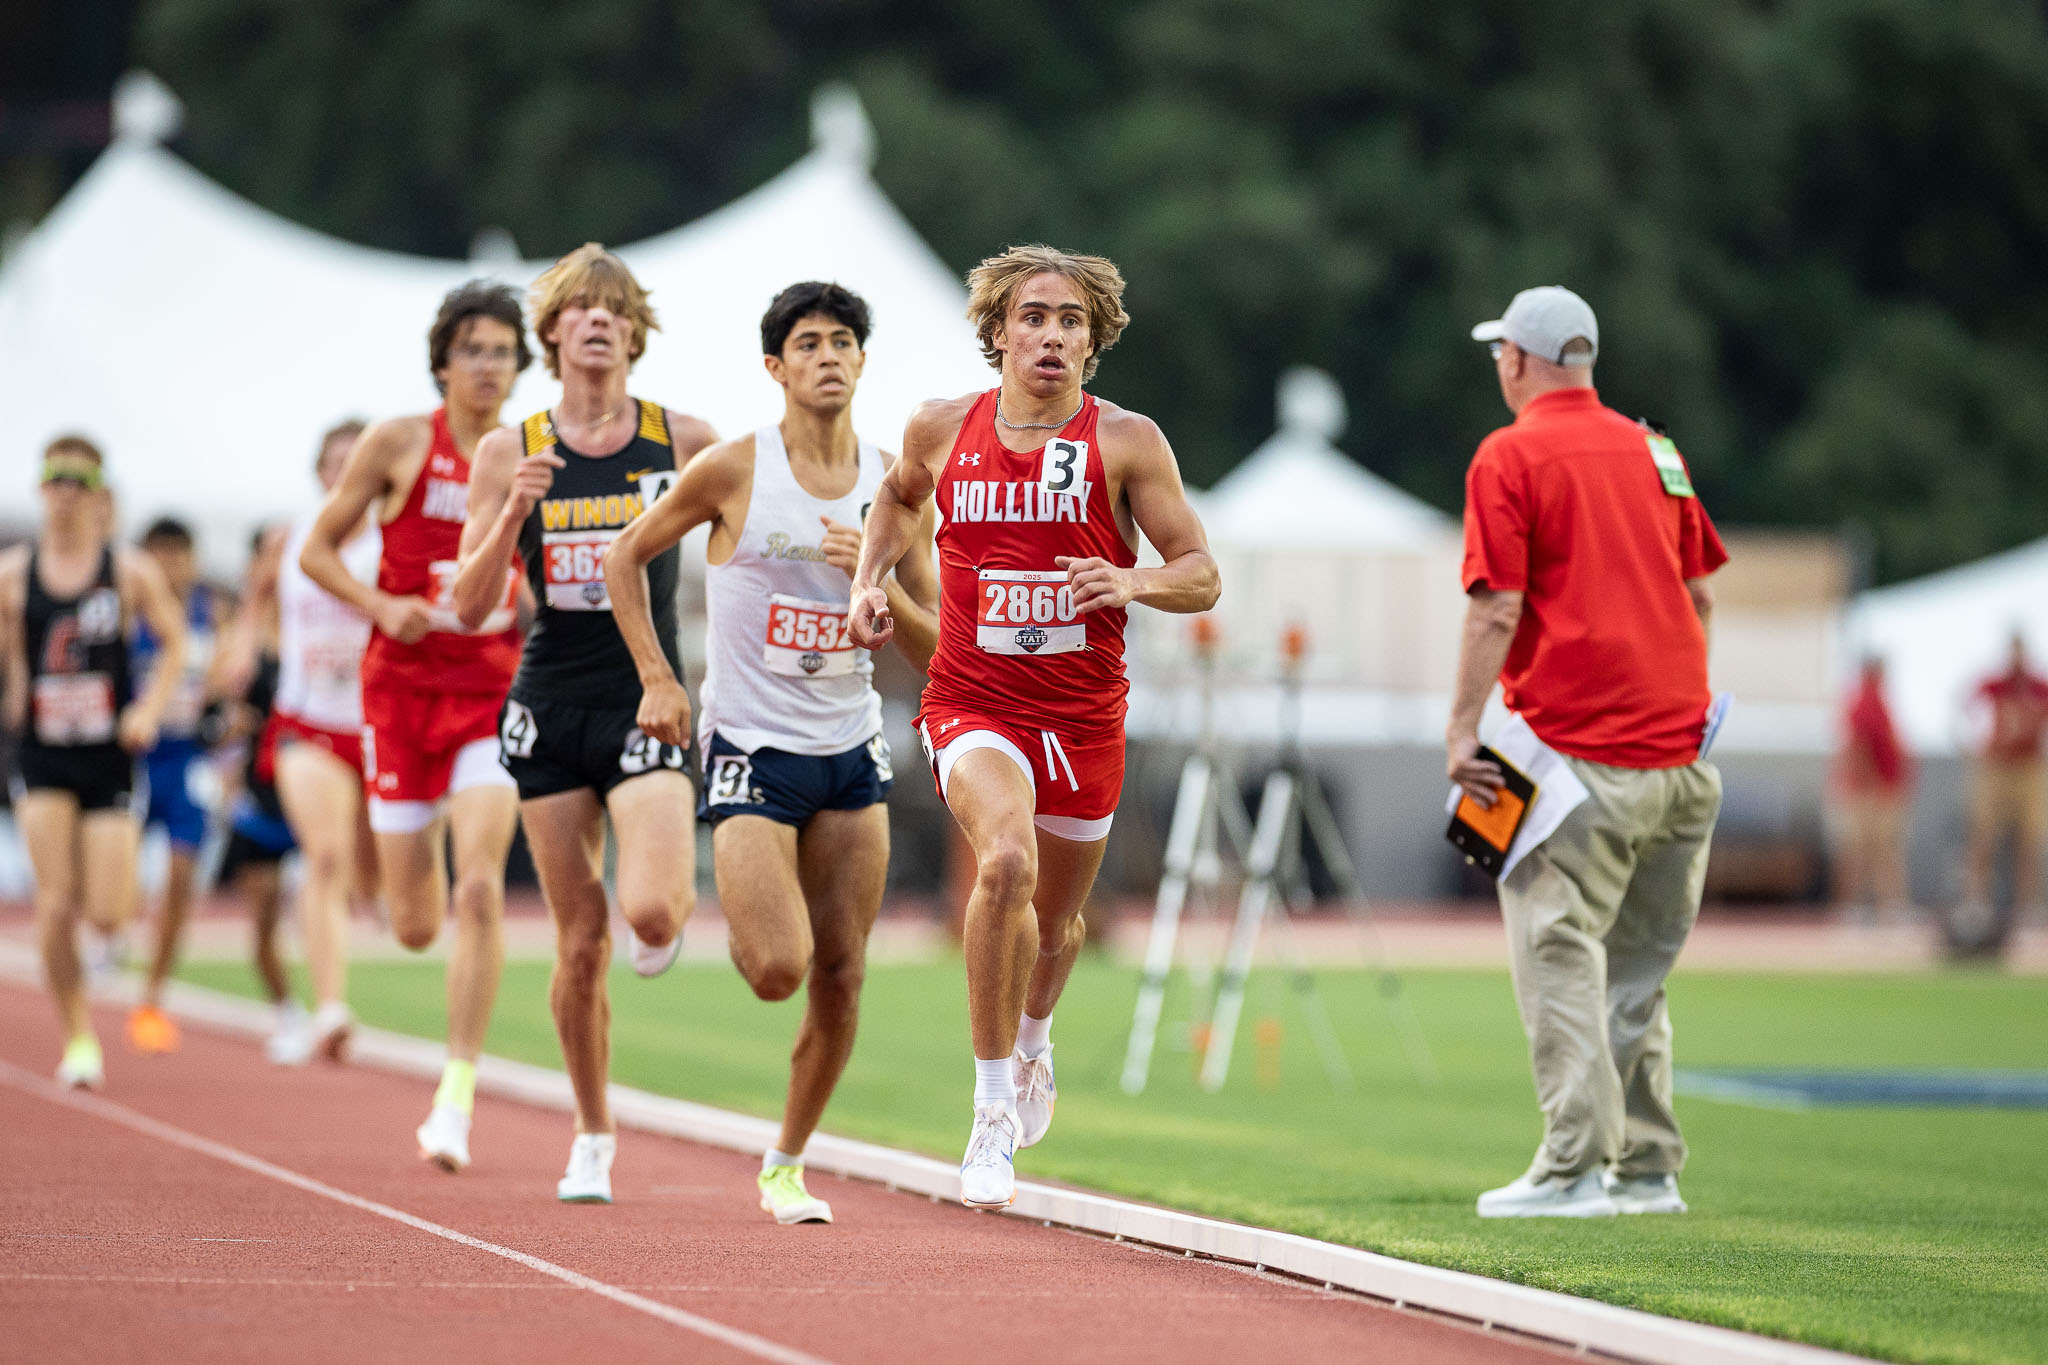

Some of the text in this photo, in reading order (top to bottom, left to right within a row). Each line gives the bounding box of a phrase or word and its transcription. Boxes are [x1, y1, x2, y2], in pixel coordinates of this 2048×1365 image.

[1047, 442, 1077, 491] 3
[951, 480, 1093, 523] HOLLIDAY
[985, 584, 1077, 623] 2860
[772, 608, 854, 650] 3532
[1015, 635, 1047, 643] STATE
[509, 711, 528, 751] 4
[718, 760, 745, 798] 9
